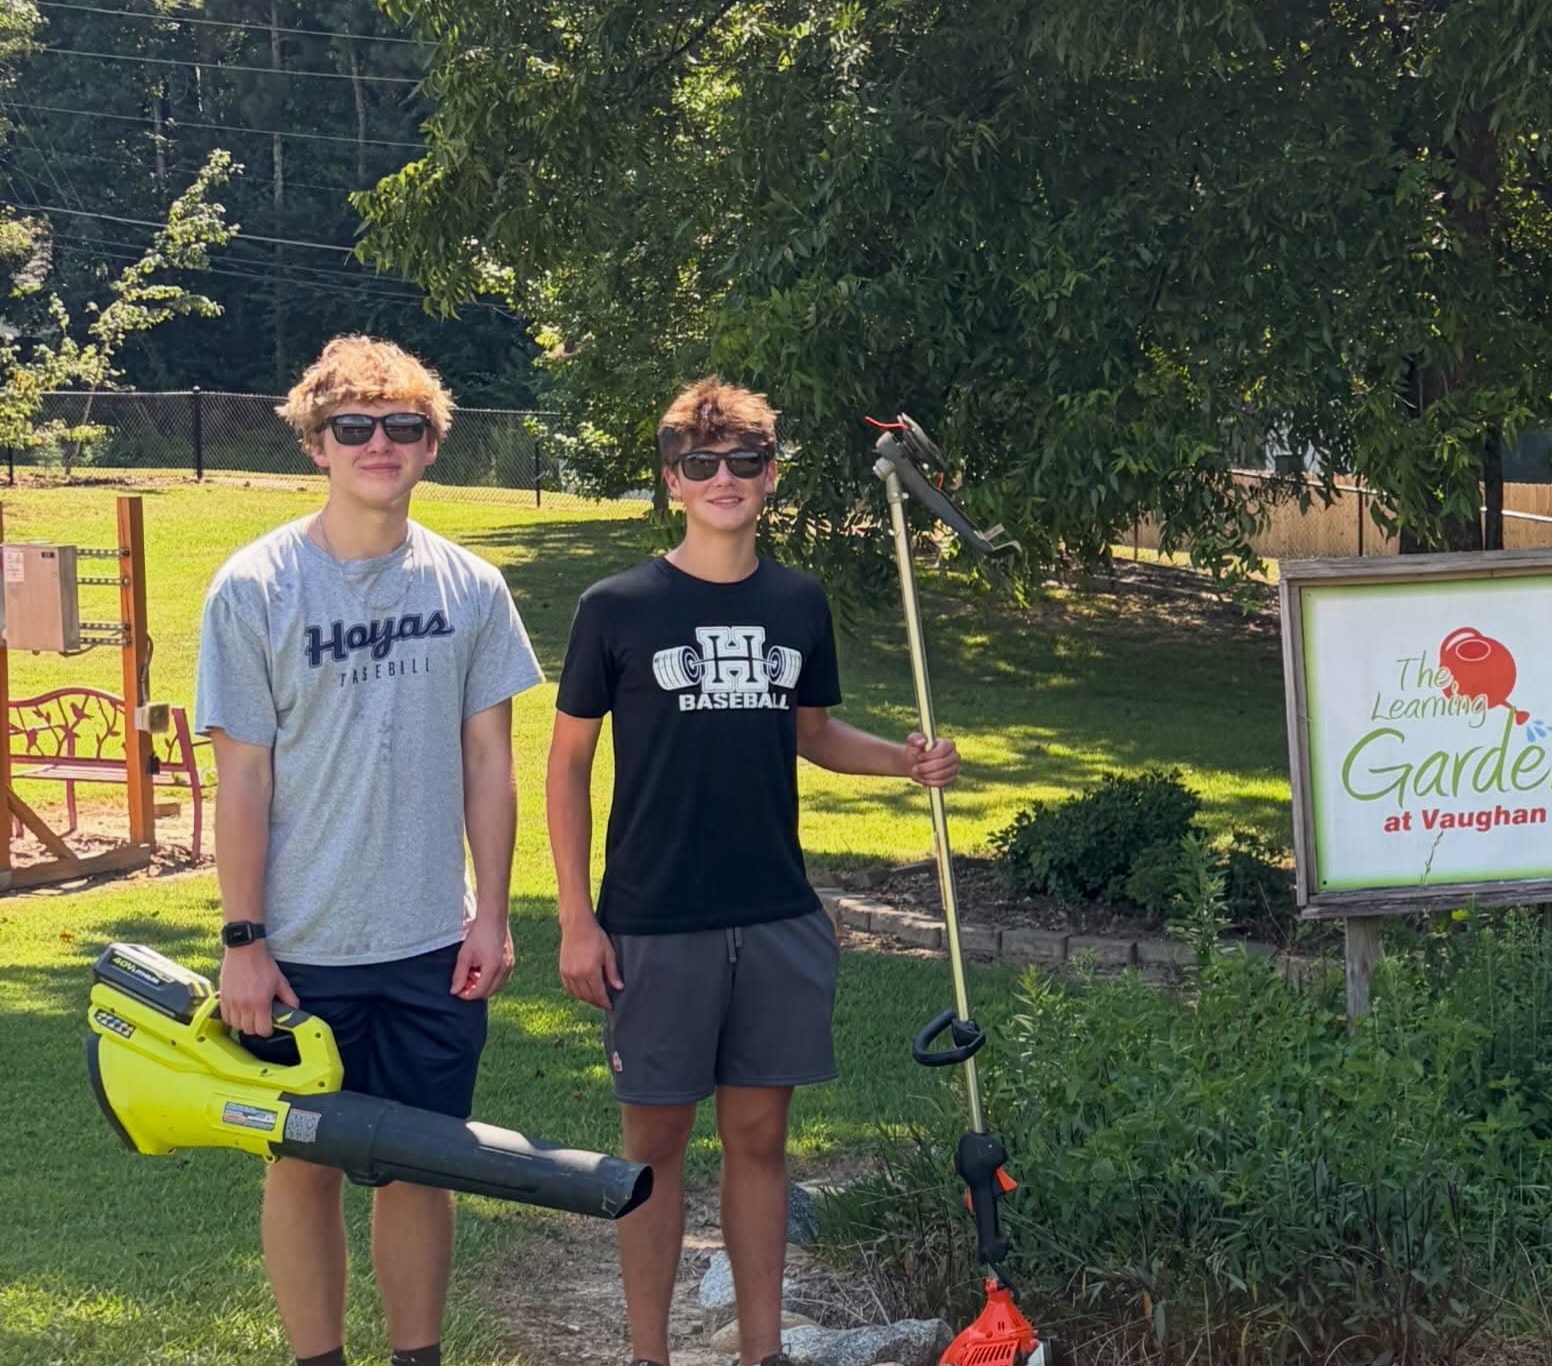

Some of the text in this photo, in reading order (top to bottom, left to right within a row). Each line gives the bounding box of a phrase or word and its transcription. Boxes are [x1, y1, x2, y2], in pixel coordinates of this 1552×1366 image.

[304, 609, 456, 669] Hoyas
[1396, 650, 1453, 690] The
[679, 692, 790, 712] BASEBALL
[1371, 681, 1488, 729] Learning
[1384, 805, 1547, 833] at Vaughan
